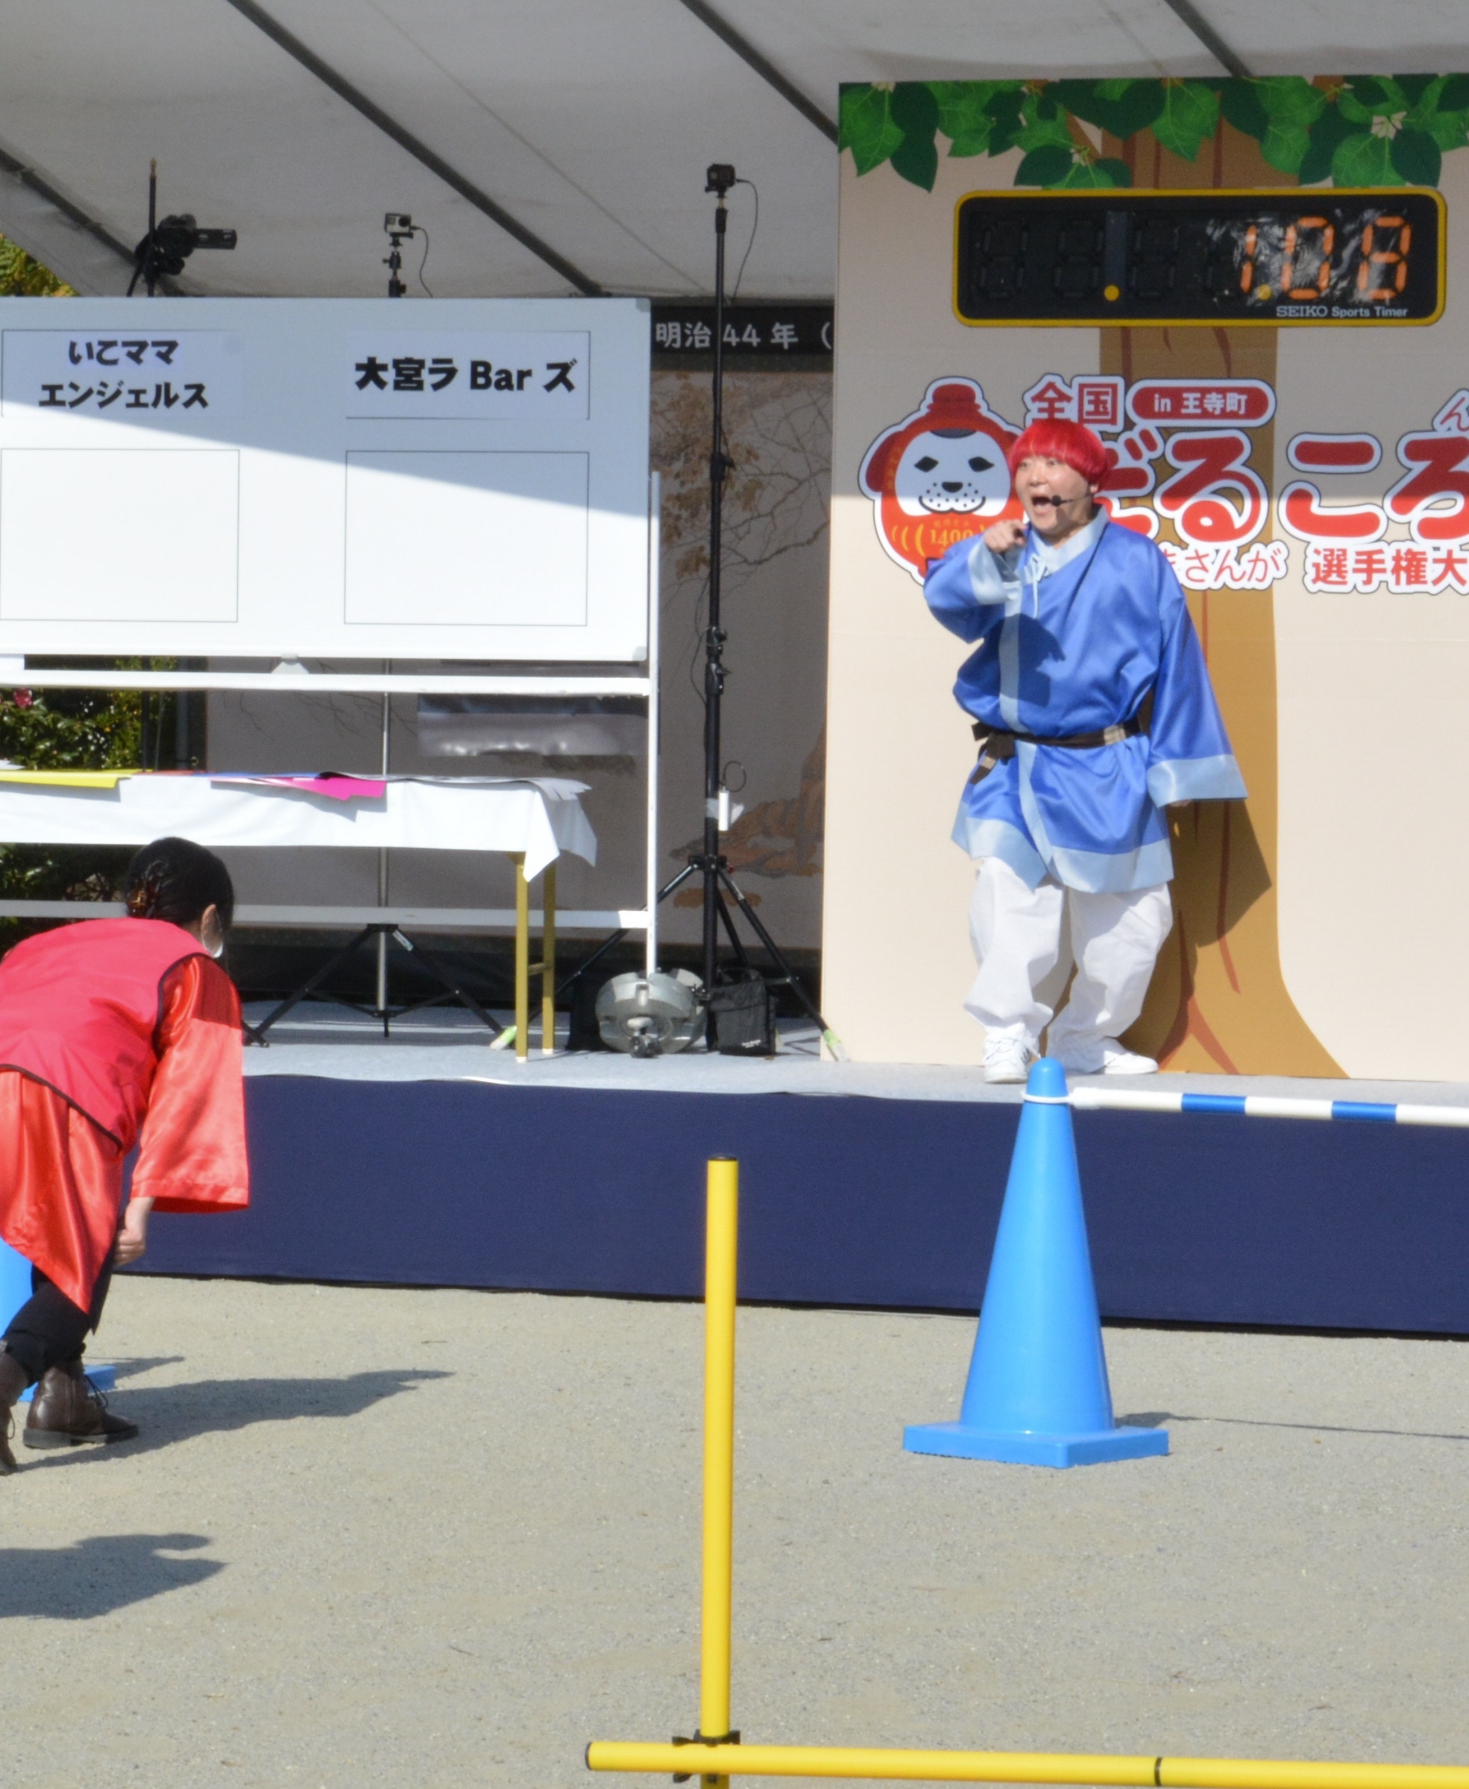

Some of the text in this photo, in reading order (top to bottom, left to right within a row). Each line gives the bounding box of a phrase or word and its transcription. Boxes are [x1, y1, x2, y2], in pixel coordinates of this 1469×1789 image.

[1276, 305, 1408, 318] SEIKO Sports Timer
[655, 322, 712, 348] 明治
[68, 340, 179, 366] いこママ
[355, 356, 459, 392] 大宮ラ
[470, 360, 533, 391] Bar
[38, 380, 209, 409] エンジェルス
[1031, 381, 1121, 426] 全国
[1311, 548, 1469, 588] 選手権大
